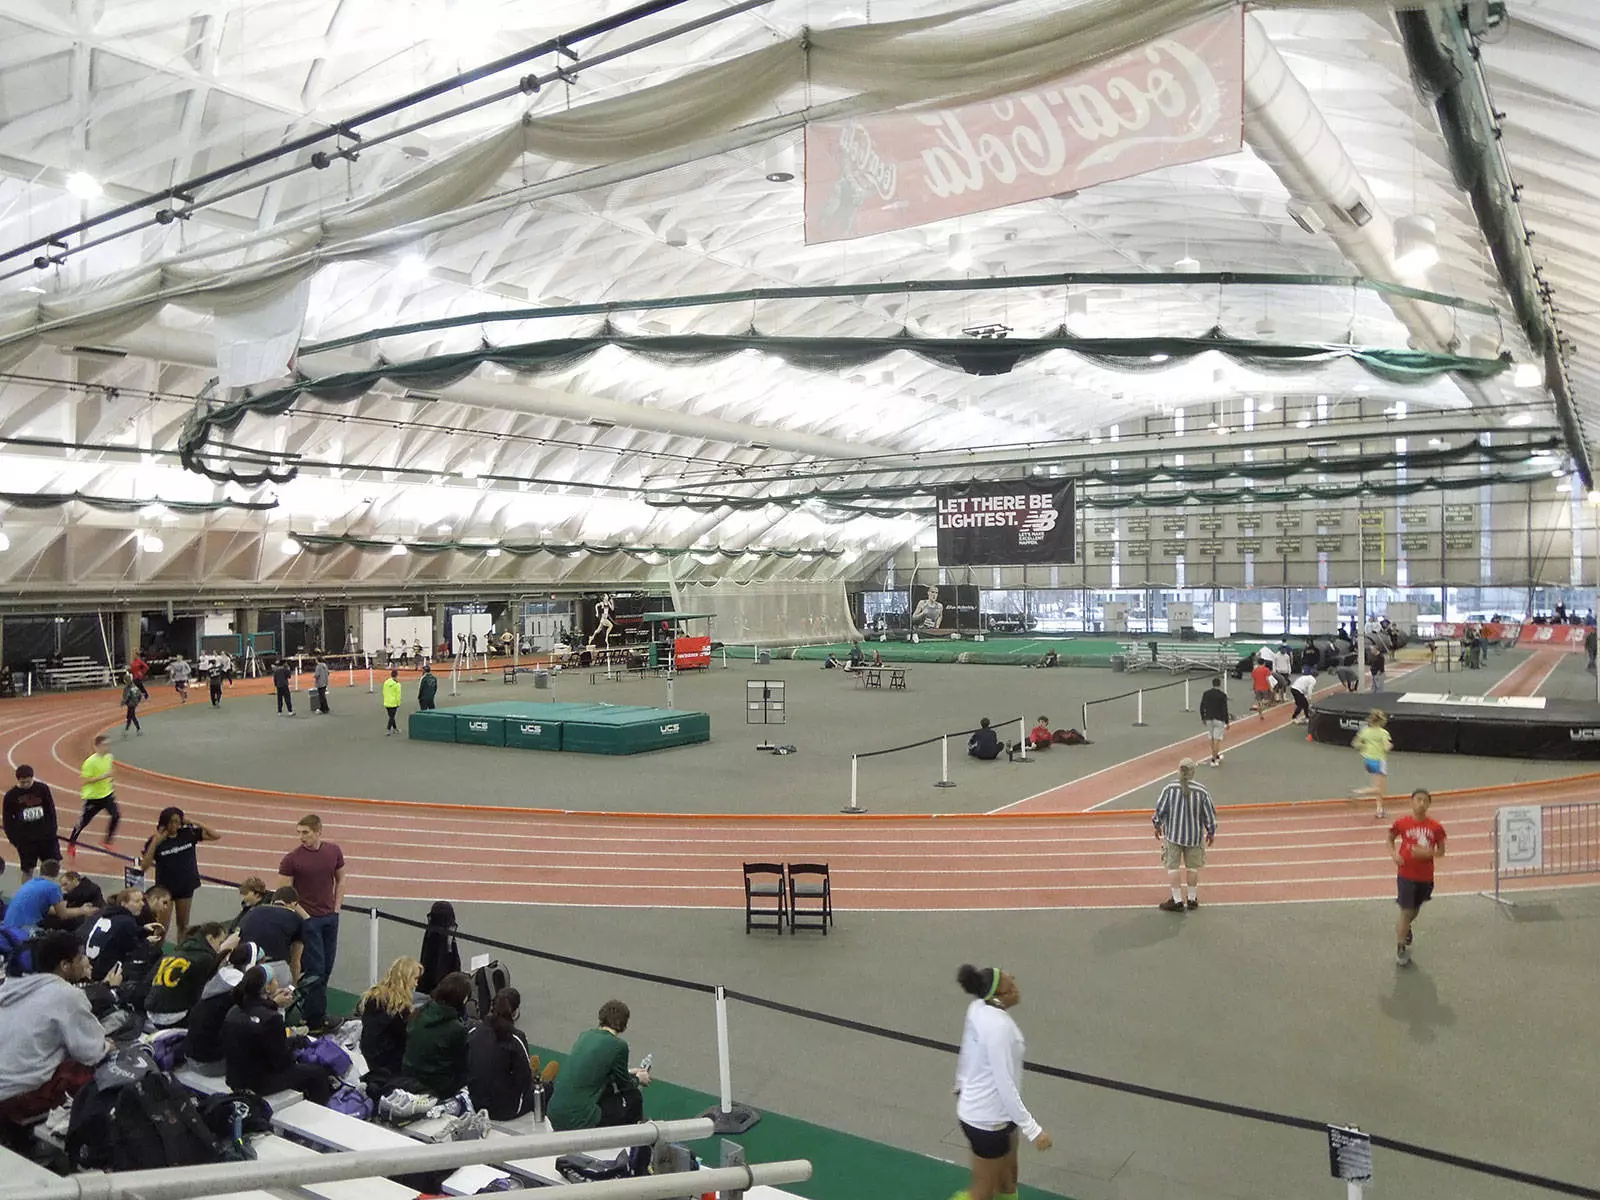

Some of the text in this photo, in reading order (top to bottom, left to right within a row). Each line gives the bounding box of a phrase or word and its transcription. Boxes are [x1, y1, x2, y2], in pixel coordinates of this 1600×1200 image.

[938, 493, 1053, 513] LET THERE BE
[938, 511, 1018, 529] LIGHTEST.
[469, 721, 488, 730] UCS
[520, 724, 542, 733] UCS
[660, 723, 680, 732] UCS
[85, 917, 112, 959] C
